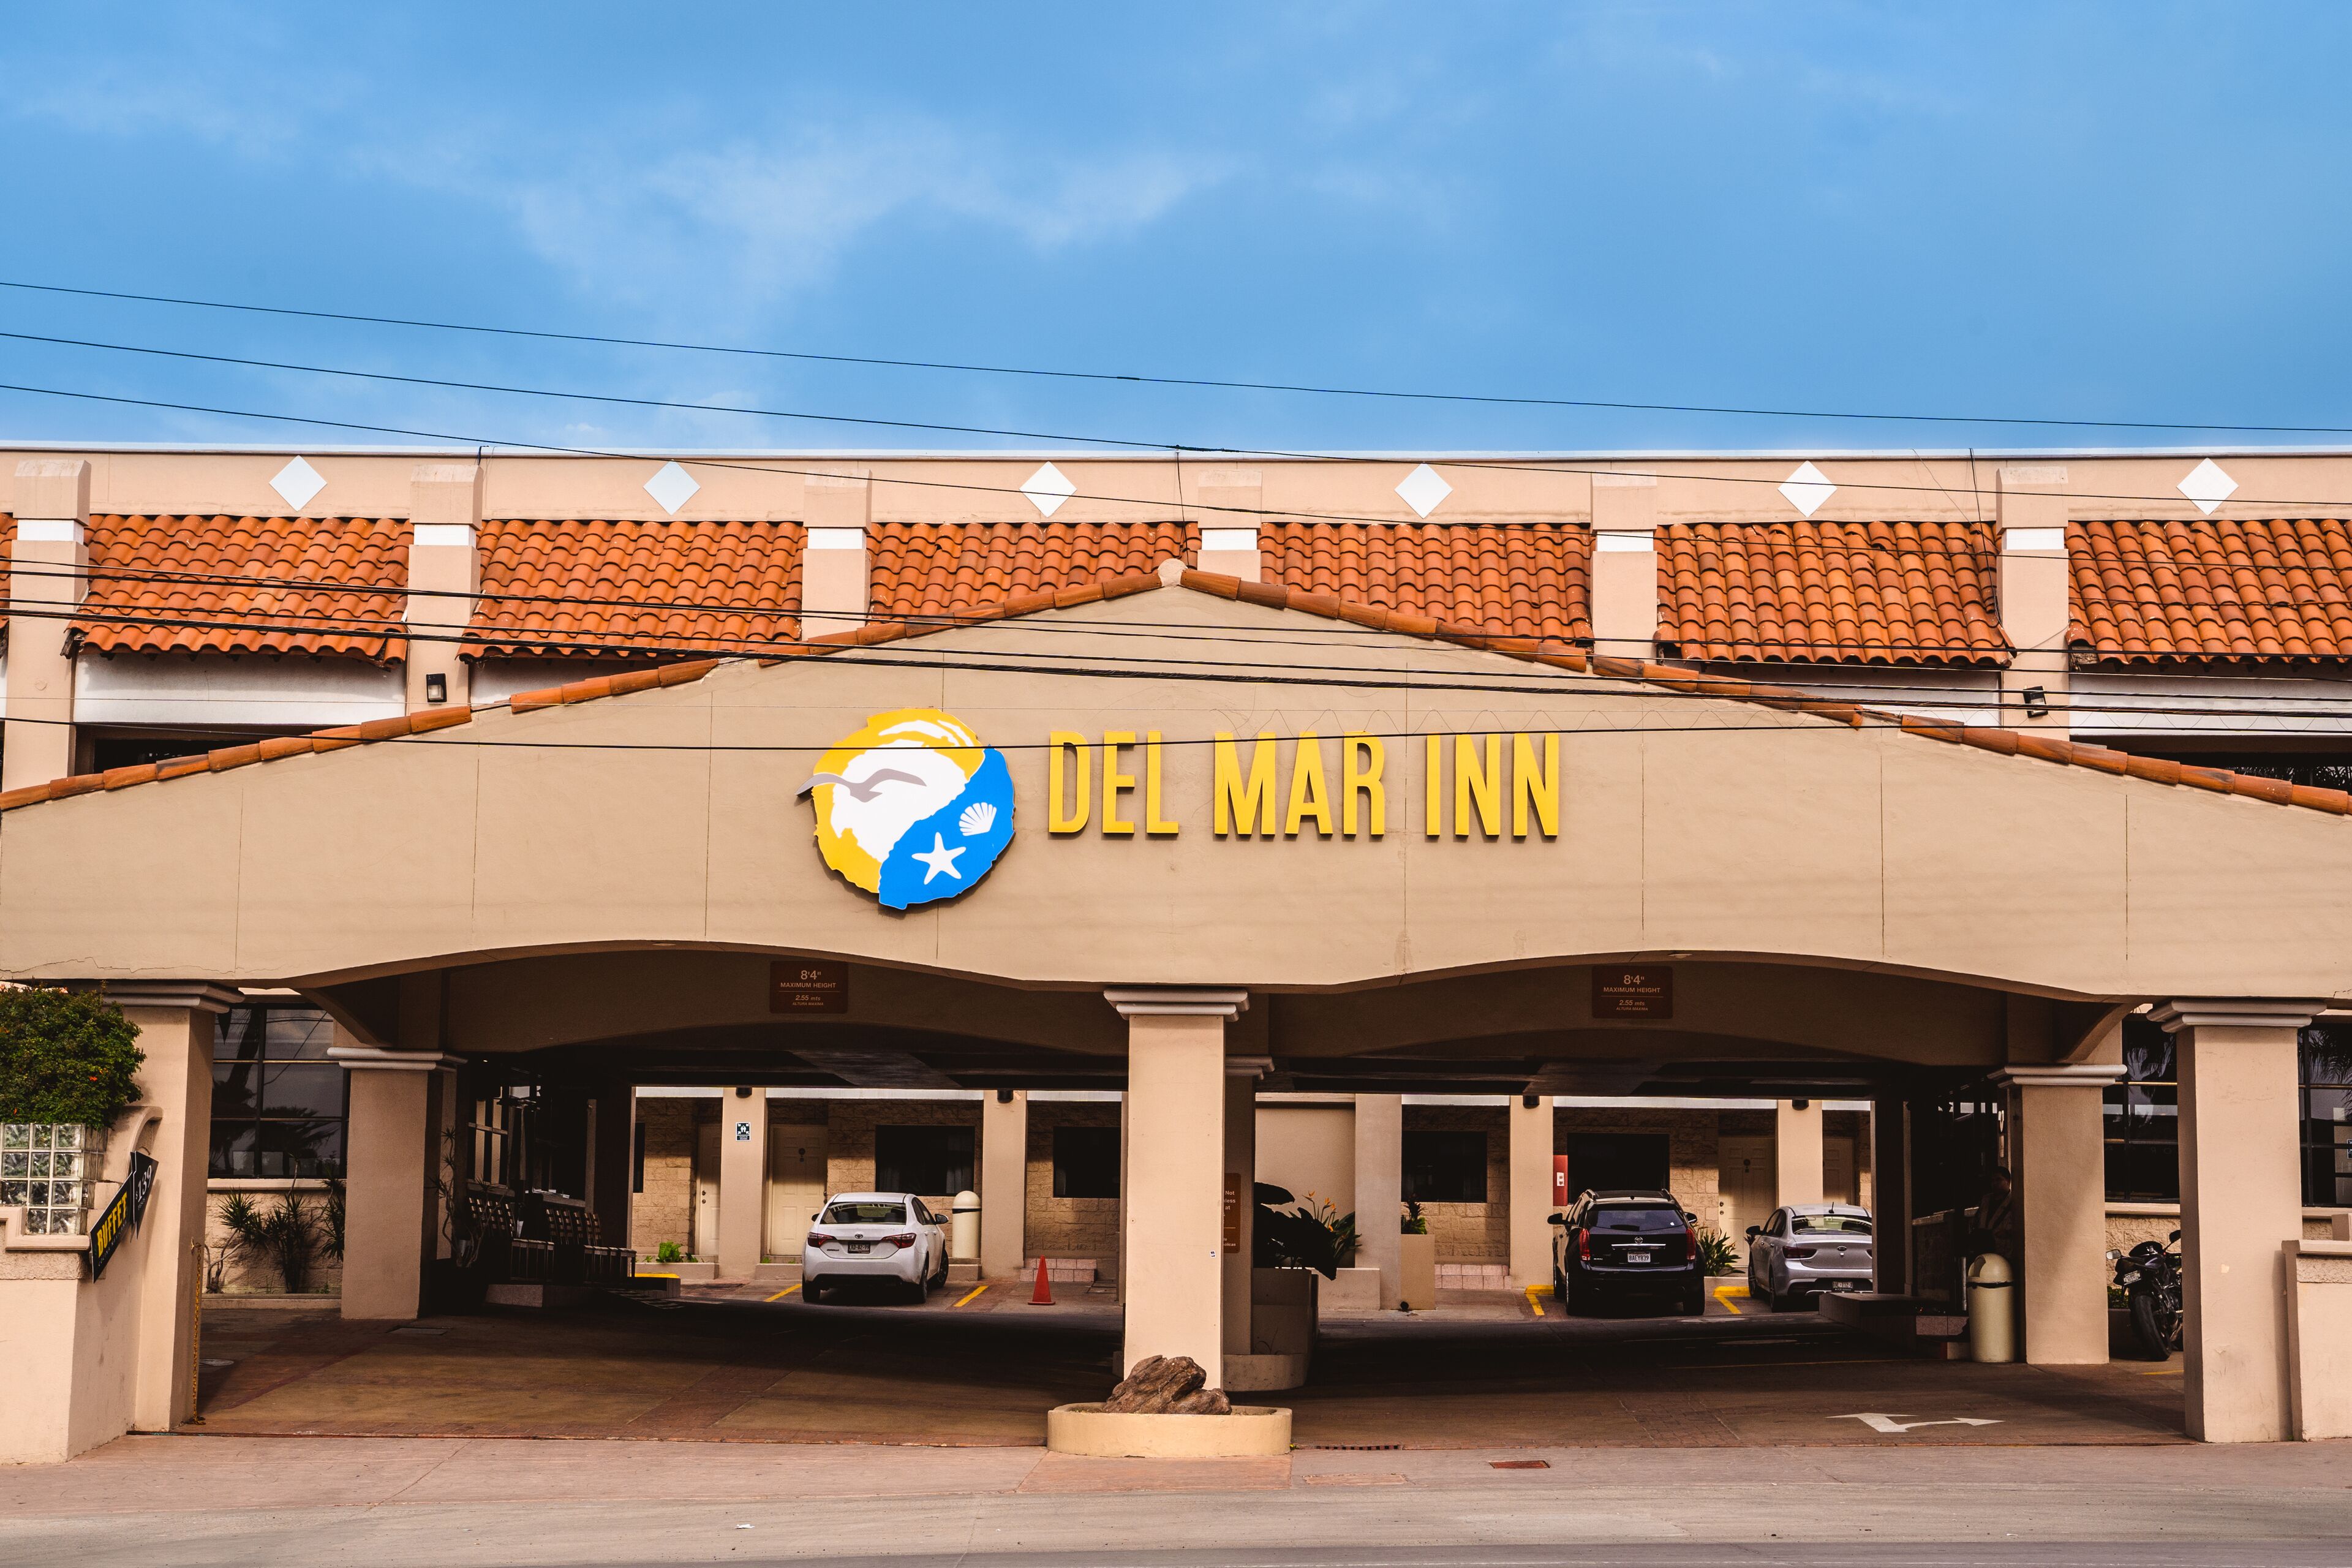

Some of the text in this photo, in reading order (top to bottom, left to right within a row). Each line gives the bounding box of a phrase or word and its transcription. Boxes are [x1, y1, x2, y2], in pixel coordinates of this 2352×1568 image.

[1049, 730, 1560, 837] DEL MAR INN
[97, 1191, 127, 1258] BUFFET
